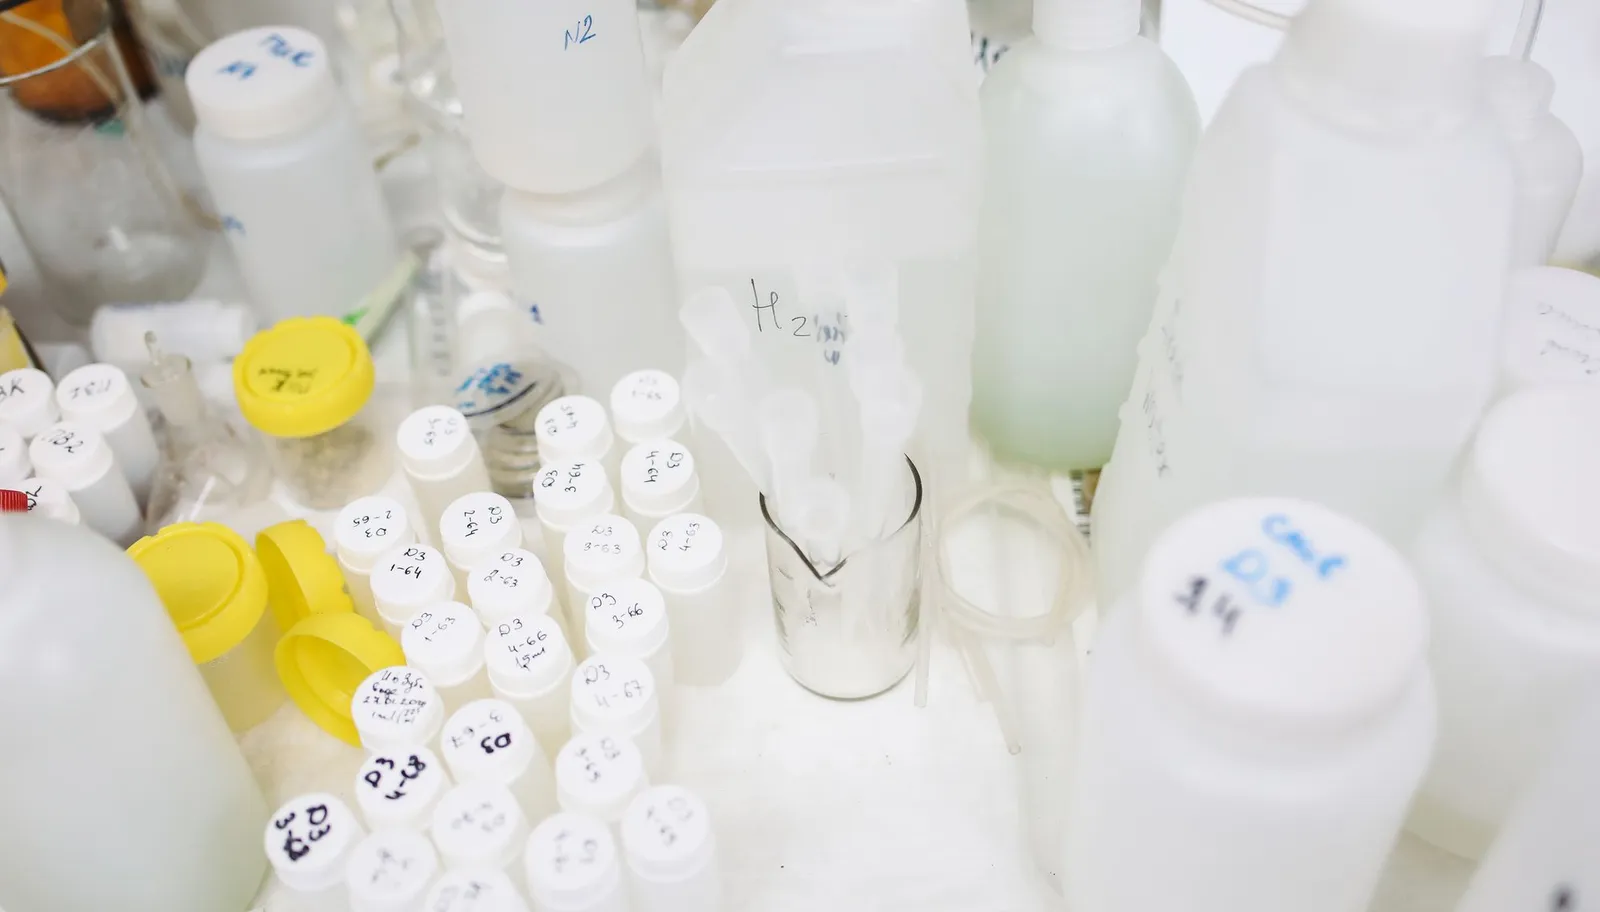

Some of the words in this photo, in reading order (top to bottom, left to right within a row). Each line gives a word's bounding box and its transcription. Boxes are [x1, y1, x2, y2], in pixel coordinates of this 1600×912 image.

[643, 449, 660, 484] 4-64
[666, 452, 684, 469] D3
[541, 468, 559, 488] D3
[563, 462, 586, 493] 3-64
[352, 509, 393, 528] 2-65
[463, 509, 479, 538] 2-64
[487, 505, 503, 525] D3
[364, 526, 388, 539] D3
[591, 524, 614, 537] D3
[657, 529, 674, 551] D3
[679, 521, 701, 552] 4-63
[403, 547, 427, 562] D3
[583, 541, 622, 555] 3-63
[500, 552, 524, 568] D3
[389, 563, 422, 580] 1-64
[483, 568, 519, 589] 2-63
[591, 592, 617, 610] D3
[411, 612, 433, 630] D3
[612, 602, 644, 630] 3-66
[423, 616, 456, 642] 1-63
[498, 618, 524, 638] D3
[507, 629, 548, 654] 4-66
[584, 664, 611, 685] D3
[593, 679, 644, 709] 4-67
[480, 732, 512, 755] D3
[364, 756, 396, 788] D3
[305, 803, 332, 842] D3
